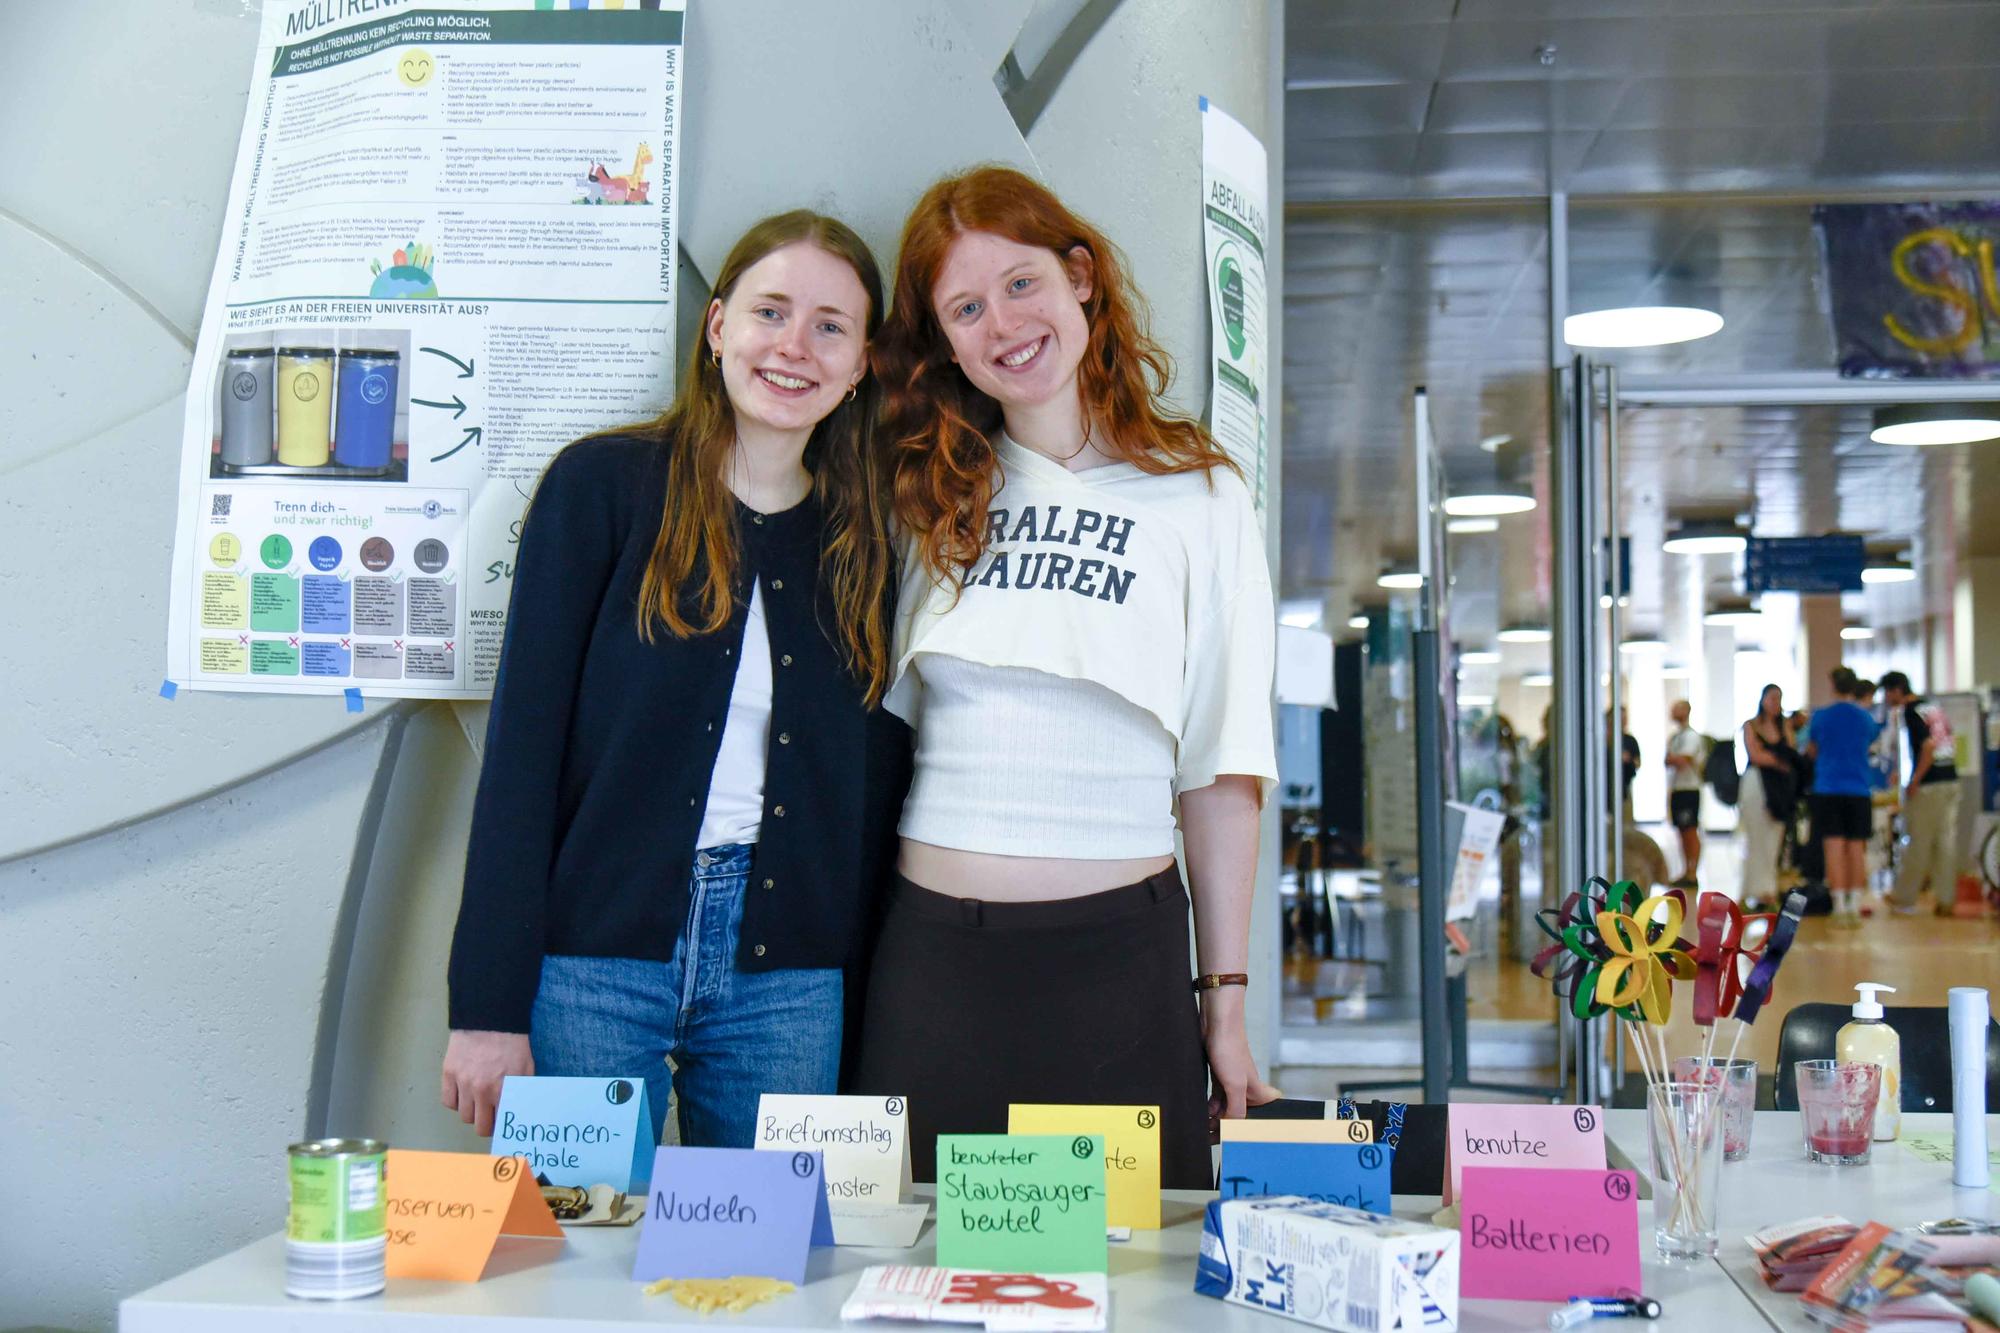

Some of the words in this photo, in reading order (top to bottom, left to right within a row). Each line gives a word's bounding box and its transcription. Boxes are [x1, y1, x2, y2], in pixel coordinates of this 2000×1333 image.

[288, 57, 322, 72] RECYCLING
[323, 56, 329, 64] IS
[330, 52, 343, 63] NOT
[343, 45, 372, 58] POSSIBLE
[373, 33, 400, 50] WITHOUT
[401, 32, 432, 41] WASTE
[434, 32, 491, 41] SEPARATION.
[291, 47, 311, 60] OHNE
[312, 31, 367, 53] MÜLLTRENNUNG
[370, 25, 386, 39] KEIN
[387, 17, 434, 33] RECYCLING
[437, 15, 491, 27] MÖGLICH.
[666, 48, 676, 77] WHY
[666, 80, 675, 91] IS
[664, 94, 674, 137] WASTE
[232, 240, 246, 282] WARUM
[245, 133, 267, 218] MÜLLTRENNUNG
[262, 79, 277, 130] WICHTIG?
[661, 139, 673, 214] SEPARATION
[1211, 180, 1247, 222] ABFALL
[660, 217, 670, 293] IMPORTANT?
[230, 310, 247, 319] WIE
[249, 306, 272, 317] SIEHT
[275, 304, 286, 314] ES
[289, 304, 303, 313] AN
[306, 303, 328, 313] DER
[332, 303, 372, 313] FREIEN
[376, 303, 454, 314] UNIVERSITÄT
[458, 305, 489, 315] AUS?
[300, 315, 318, 323] FREE
[320, 315, 372, 324] UNIVERSITY?
[274, 501, 306, 512] Trenn
[311, 501, 335, 513] dich
[274, 513, 296, 525] und
[300, 516, 325, 526] zwar
[330, 514, 373, 529] richtig!
[987, 505, 1136, 556] RALPH
[471, 610, 504, 619] WIESO
[502, 1112, 622, 1145] Bananen-
[763, 1115, 892, 1153] Briefumschlag
[1465, 1129, 1549, 1157] benutze
[951, 1143, 1039, 1166] benutzter
[1105, 1152, 1137, 1171] rte
[825, 1177, 880, 1198] enster
[945, 1173, 1105, 1212] Staubsauger-
[387, 1198, 494, 1219] nserven-
[655, 1191, 756, 1225] Nudeln
[962, 1207, 1045, 1233] beutel
[1471, 1214, 1610, 1255] Batterien
